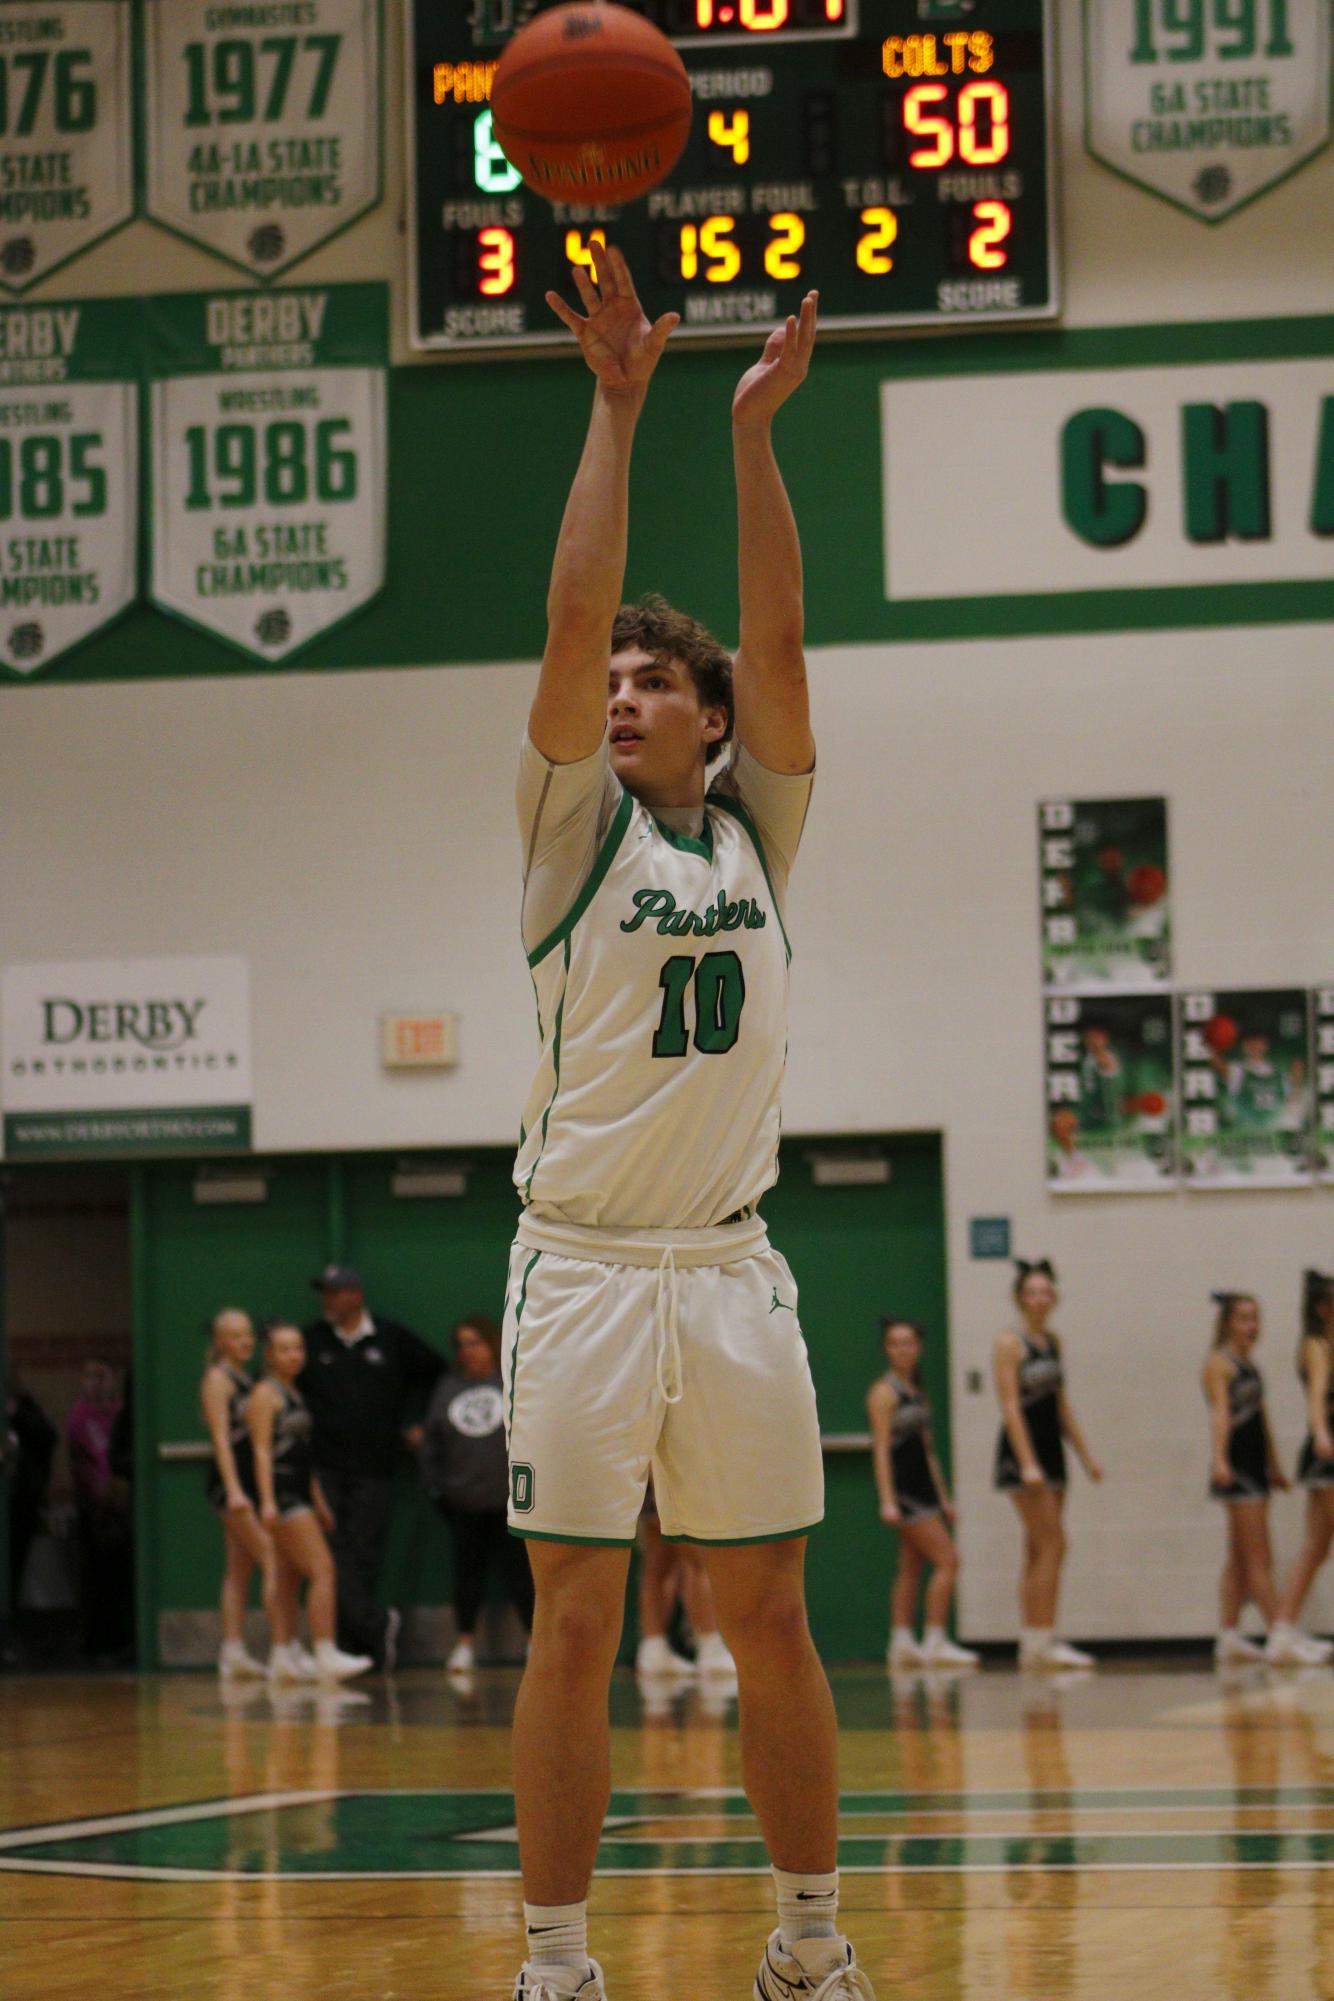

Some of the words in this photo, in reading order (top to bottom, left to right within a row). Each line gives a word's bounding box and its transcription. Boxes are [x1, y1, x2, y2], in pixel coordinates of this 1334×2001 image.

[1128, 0, 1295, 64] 1991
[882, 31, 994, 78] COLTS
[0, 51, 98, 137] 76
[183, 34, 341, 128] 1977
[1195, 77, 1270, 112] STATE
[708, 109, 750, 165] 4
[903, 80, 1009, 168] 50
[1130, 113, 1292, 153] CHAMPIONS
[2, 152, 71, 188] STATE
[269, 133, 341, 172] STATE
[189, 174, 341, 214] CHAMPIONS
[648, 188, 745, 219] PLAYER
[751, 182, 818, 213] FOUL
[938, 170, 1022, 203] FOULS
[443, 202, 525, 231] FOULS
[968, 199, 1011, 269] 2
[680, 214, 741, 283] 15
[764, 211, 806, 281] 2
[856, 206, 898, 275] 2
[478, 226, 514, 296] 3
[685, 292, 776, 322] MATCH
[937, 280, 1021, 312] SCORE
[206, 293, 328, 345] DERBY
[444, 304, 526, 337] SCORE
[218, 387, 320, 414] WRESTLING
[183, 418, 358, 512] 1986
[8, 536, 79, 573] STATE
[254, 521, 328, 557] STATE
[196, 557, 348, 598] CHAMPIONS
[42, 996, 206, 1050] DERBY
[652, 951, 746, 1058] 10
[12, 1052, 239, 1078] ORTHODONTICS
